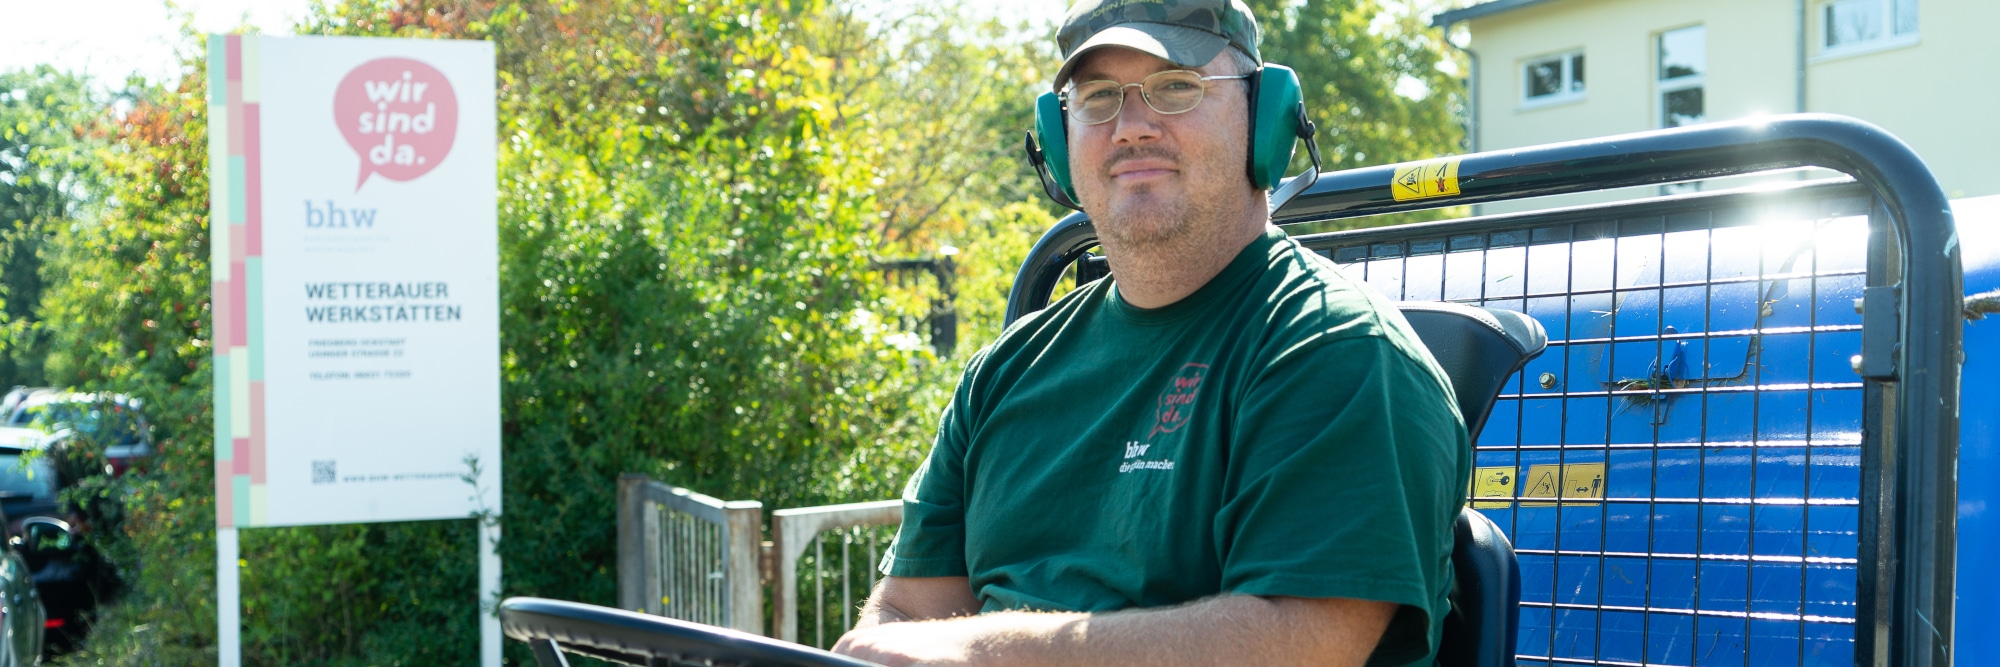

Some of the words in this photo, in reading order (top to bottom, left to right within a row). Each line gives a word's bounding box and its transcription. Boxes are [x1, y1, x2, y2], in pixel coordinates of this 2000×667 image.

[1088, 2, 1118, 20] JOHN
[364, 70, 430, 104] wir
[358, 101, 436, 134] sind
[369, 133, 427, 166] da.
[304, 200, 378, 229] bhw
[305, 282, 449, 300] WETTERAUER
[305, 300, 461, 323] WERKSTÄTTEN
[1164, 388, 1199, 406] sind
[1124, 440, 1151, 459] bhw
